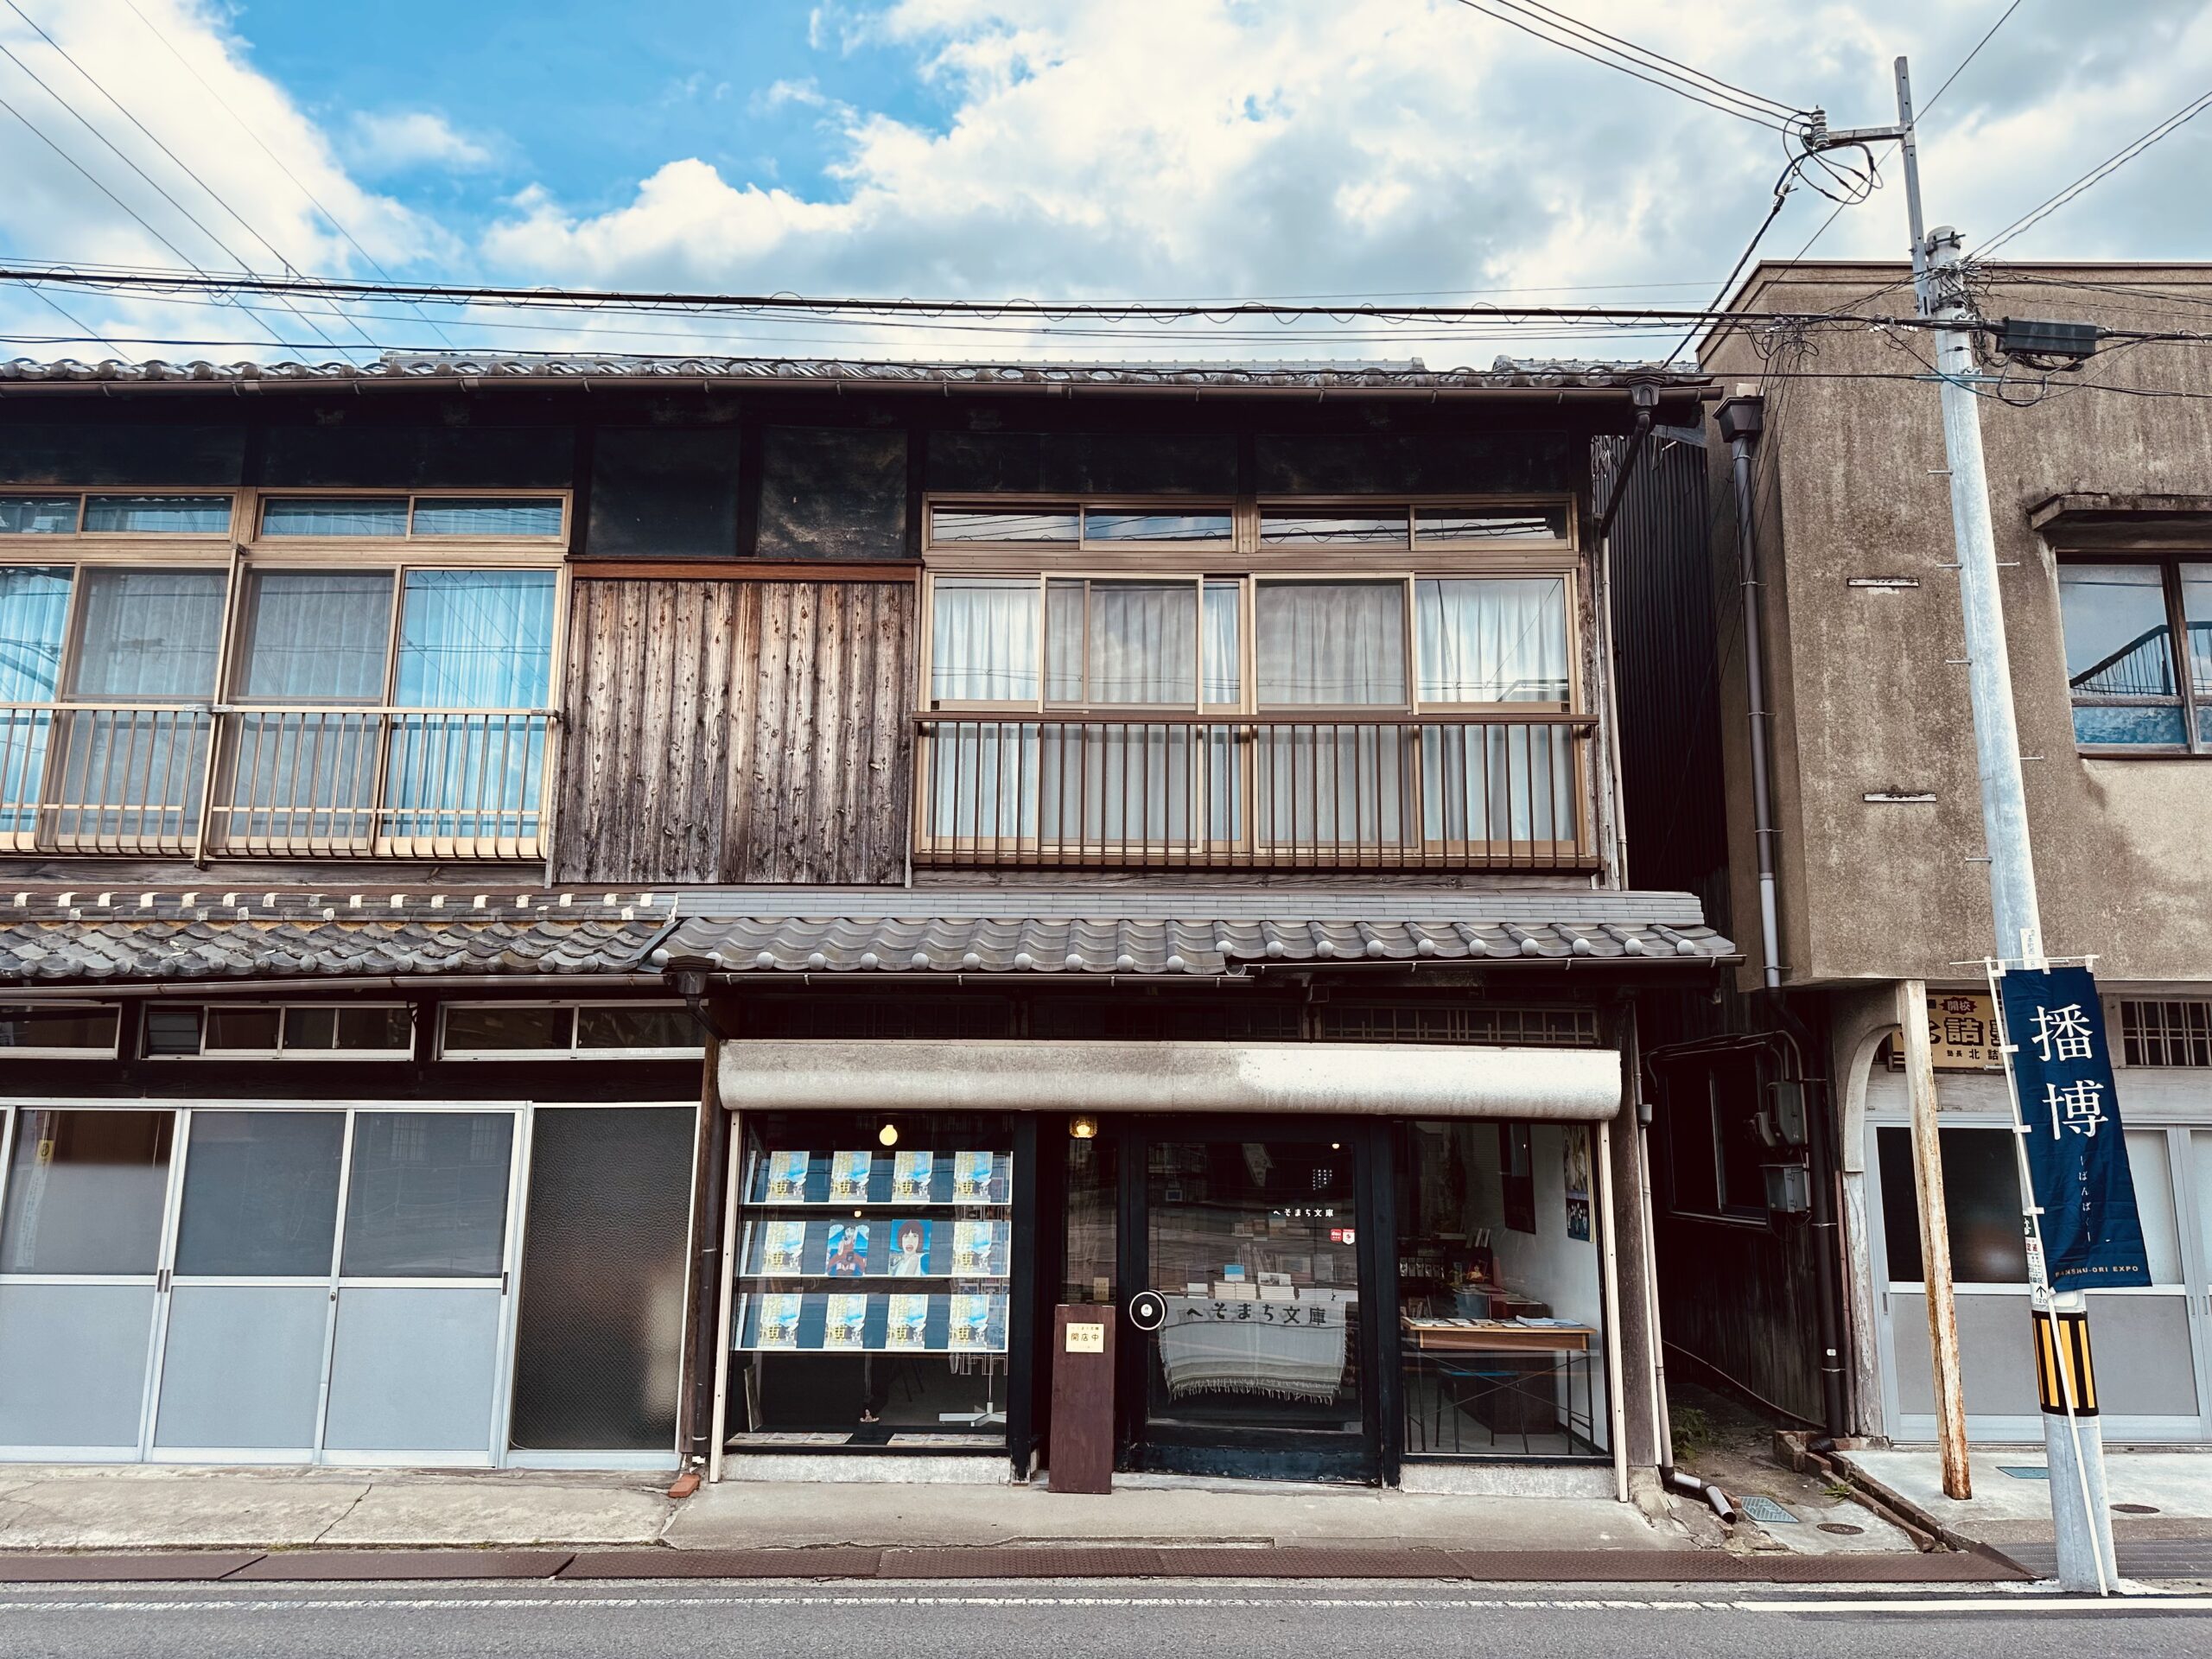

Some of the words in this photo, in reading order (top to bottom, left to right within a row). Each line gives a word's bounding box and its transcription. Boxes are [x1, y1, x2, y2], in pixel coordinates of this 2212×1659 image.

[1947, 1001, 1971, 1012] 開校
[2029, 1003, 2109, 1141] 播博
[1273, 1208, 1334, 1217] へそまち文庫
[1186, 1302, 1326, 1325] へそまち文庫
[1071, 1332, 1099, 1342] 開店中
